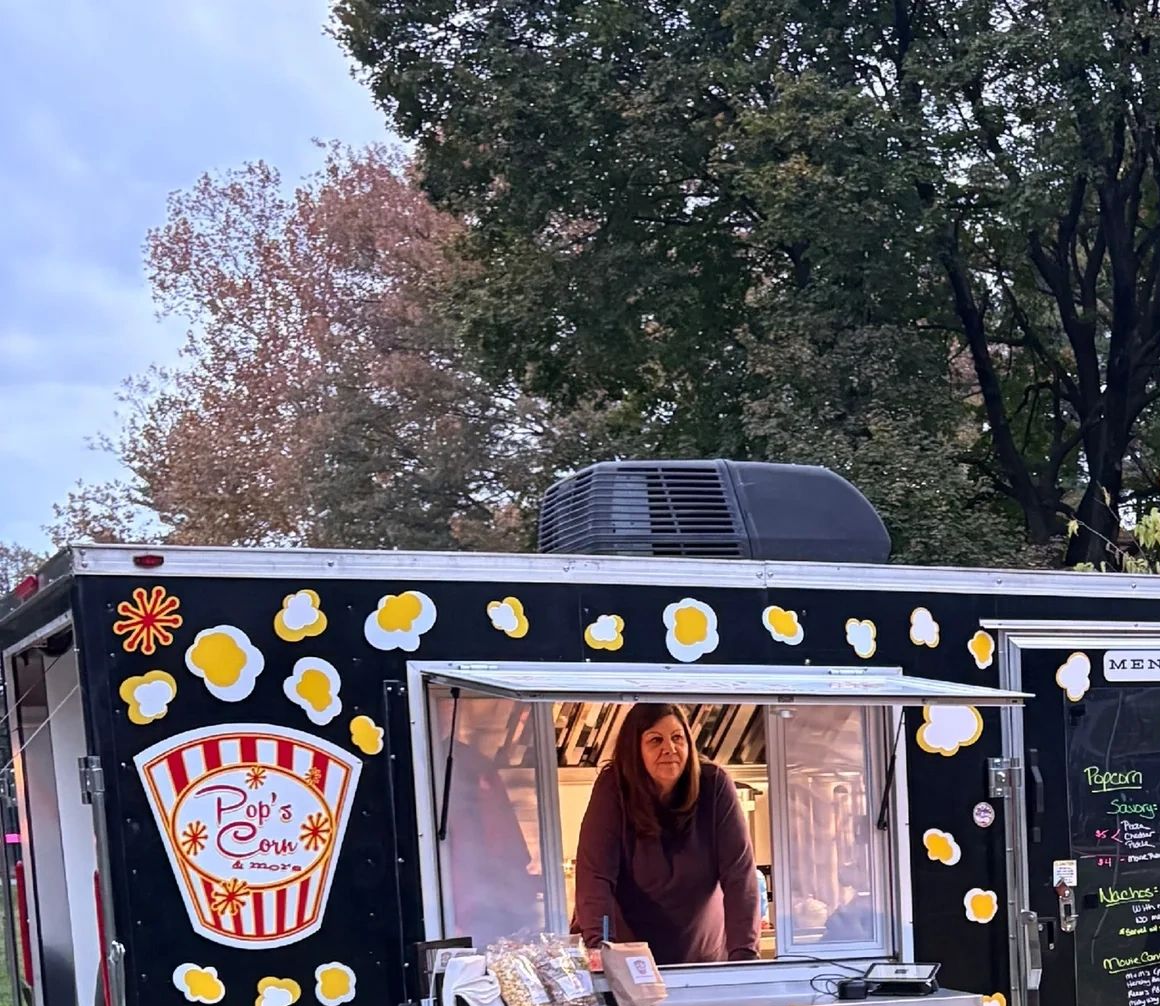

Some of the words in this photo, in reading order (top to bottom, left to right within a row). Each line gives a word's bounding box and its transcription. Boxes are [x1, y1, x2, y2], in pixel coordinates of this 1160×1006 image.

[1084, 766, 1142, 791] Popcorn
[195, 785, 293, 825] Pop's
[1106, 799, 1158, 819] Savory:
[216, 821, 298, 858] Corn
[1124, 832, 1156, 841] Cheddar
[232, 860, 244, 870] &
[250, 861, 302, 872] more
[1099, 886, 1158, 903] Nachos:
[1103, 957, 1140, 970] Movie
